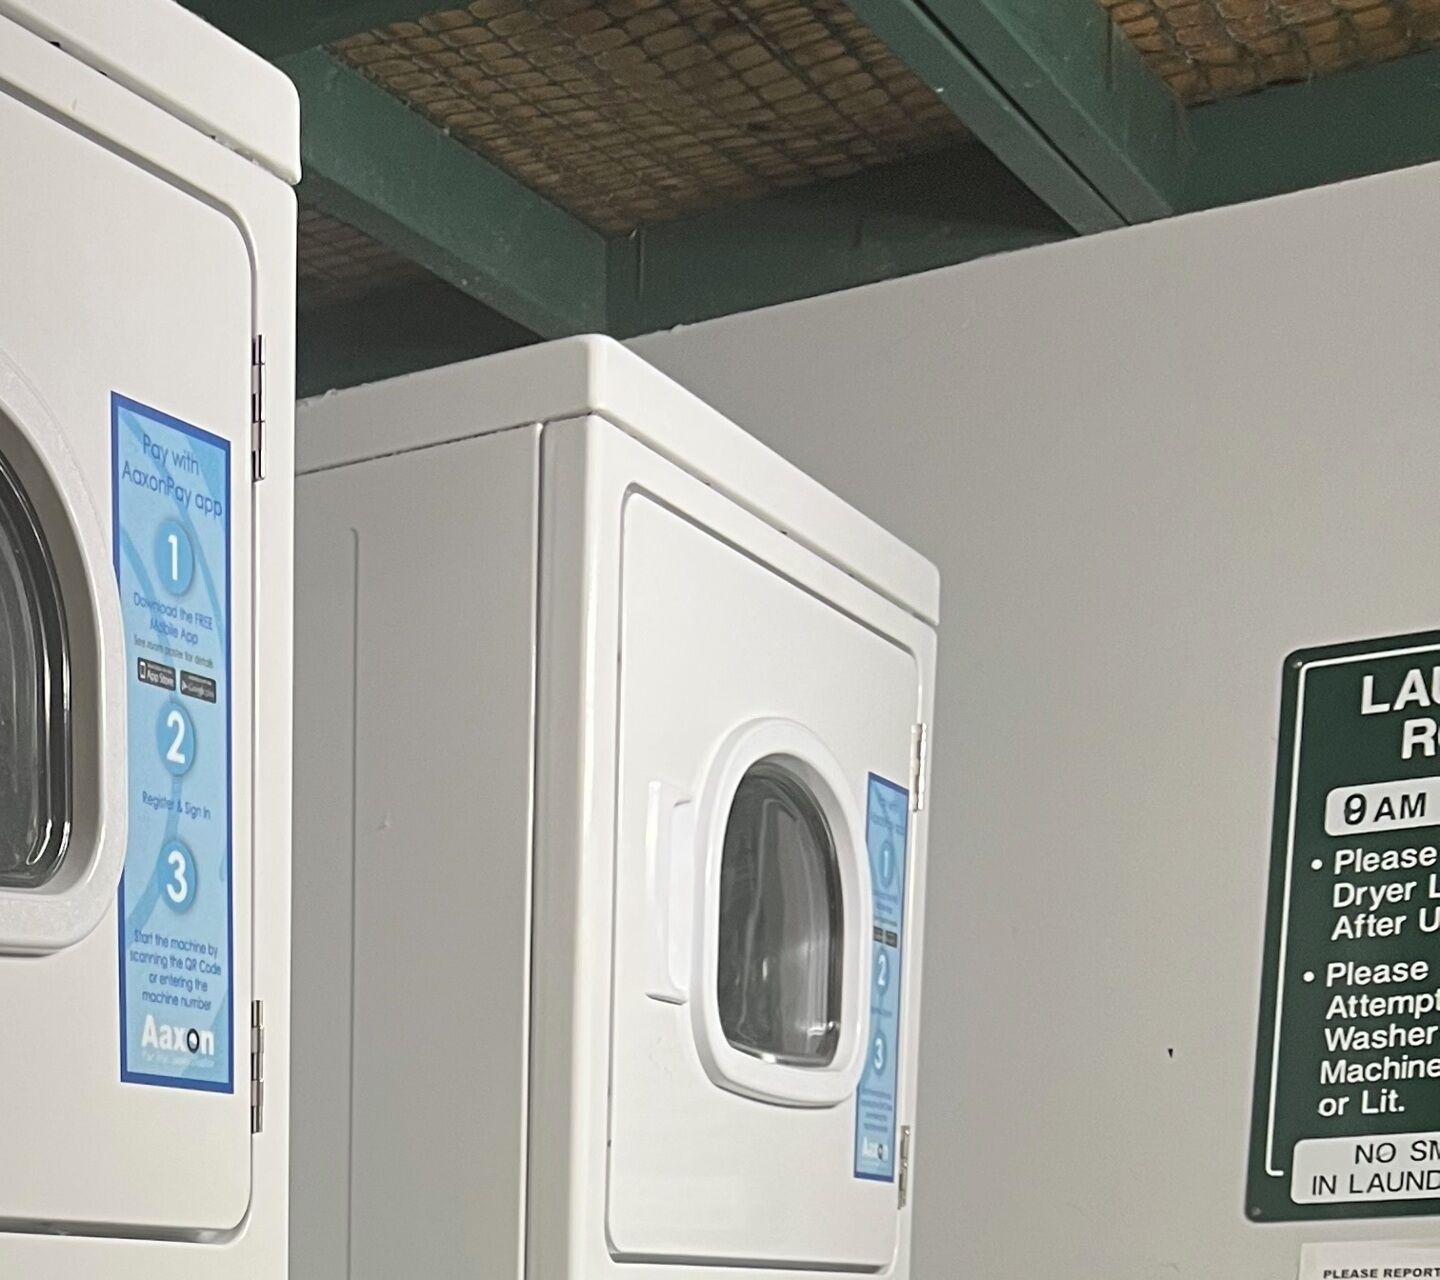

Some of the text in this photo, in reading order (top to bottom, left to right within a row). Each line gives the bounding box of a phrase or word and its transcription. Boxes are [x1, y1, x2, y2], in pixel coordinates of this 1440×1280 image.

[142, 433, 199, 475] Pay with
[122, 460, 222, 519] AaxonPay app
[168, 534, 177, 580] 1
[181, 628, 198, 645] App
[1361, 666, 1440, 714] LA
[167, 710, 185, 763] 2
[1402, 718, 1440, 759] R
[1344, 792, 1427, 826] 9 AM
[1334, 846, 1437, 874] Please
[167, 850, 188, 902] 3
[1333, 882, 1417, 911] Dryer
[1331, 913, 1407, 940] After
[134, 930, 218, 958] Start the machine by
[170, 955, 183, 969] the
[185, 957, 197, 971] QR
[199, 960, 221, 975] Code
[1326, 960, 1429, 988] Please
[149, 973, 208, 992] or entering the
[142, 991, 211, 1011] machine number
[142, 1014, 214, 1056] Aaxon
[1325, 1023, 1438, 1051] Washer
[1321, 1055, 1440, 1084] Machine
[1318, 1089, 1405, 1116] or Lit.
[1355, 1143, 1396, 1164] NO
[1313, 1175, 1336, 1195] IN
[1323, 1268, 1440, 1279] PLEASE REPORT
